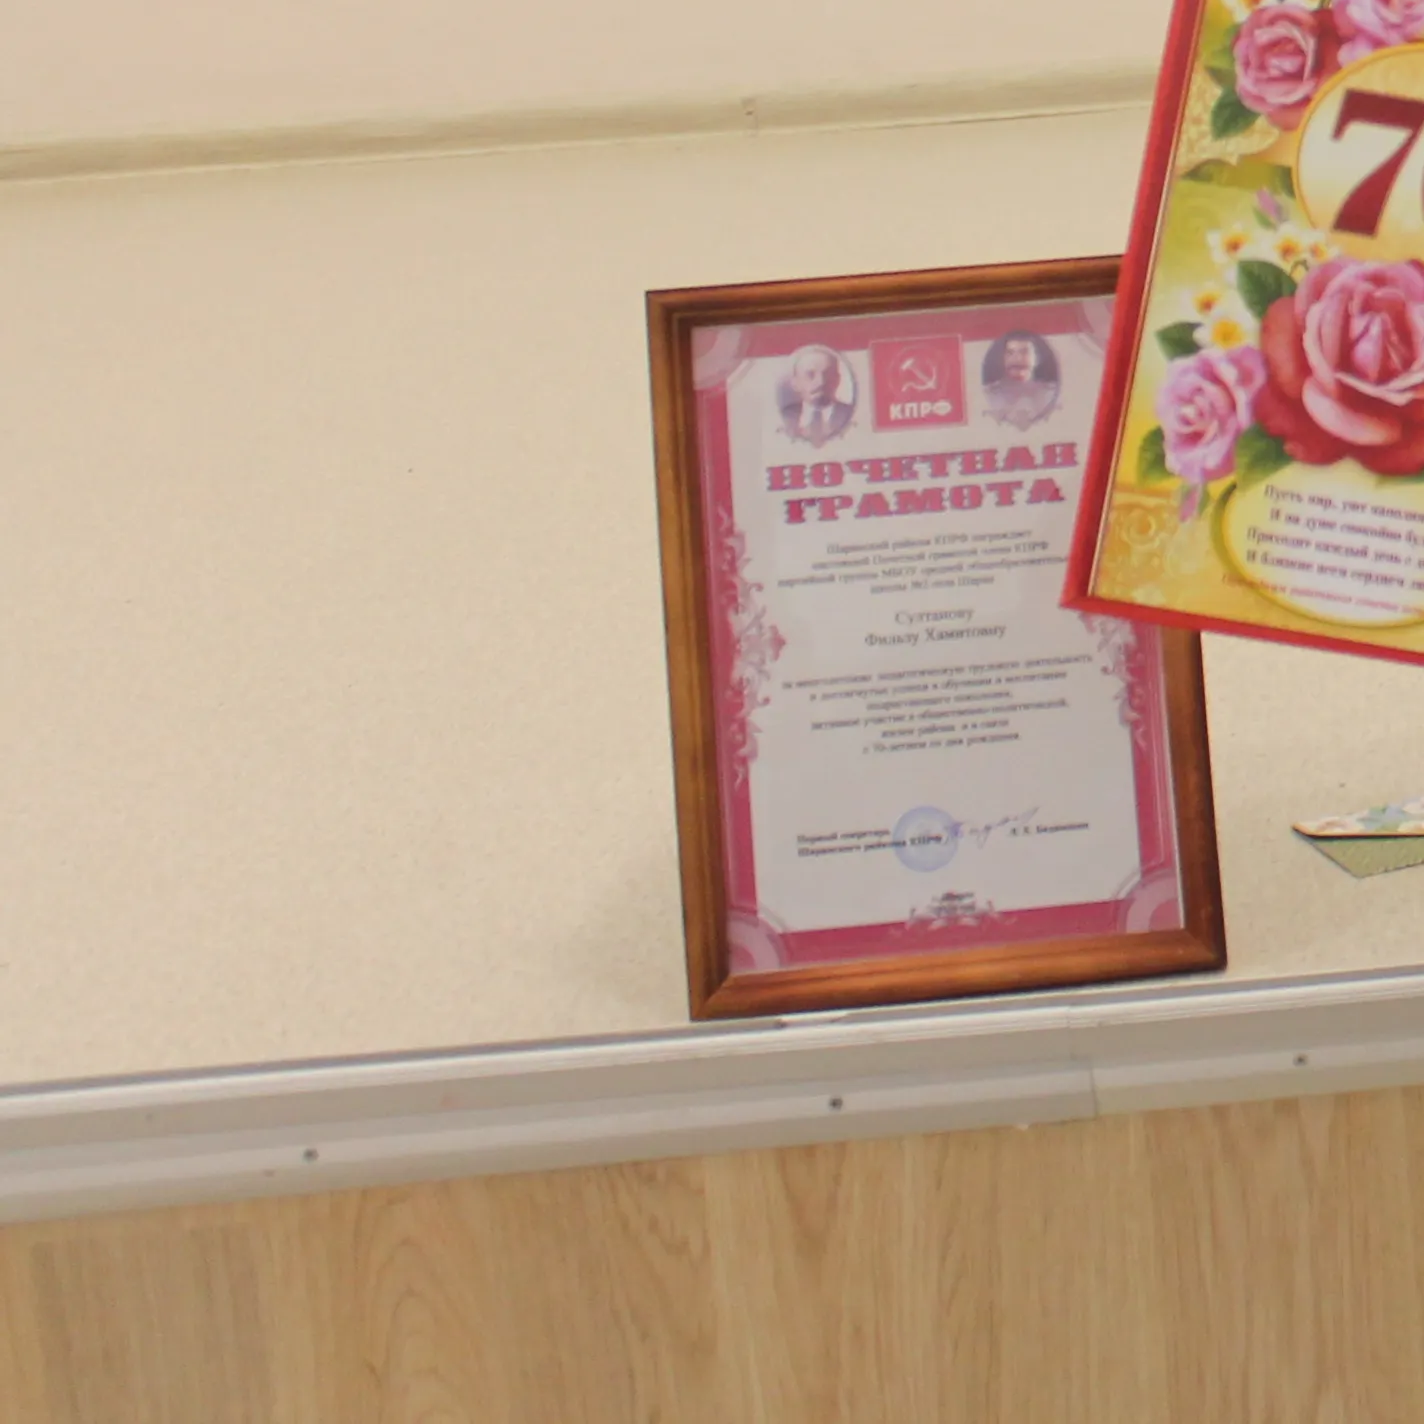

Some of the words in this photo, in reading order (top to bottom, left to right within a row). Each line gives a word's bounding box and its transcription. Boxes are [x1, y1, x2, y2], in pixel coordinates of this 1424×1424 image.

[889, 399, 953, 422] КПРФ
[766, 442, 1079, 492] ПОЧЕТНАЯ
[784, 477, 1066, 524] ГРАМОТА
